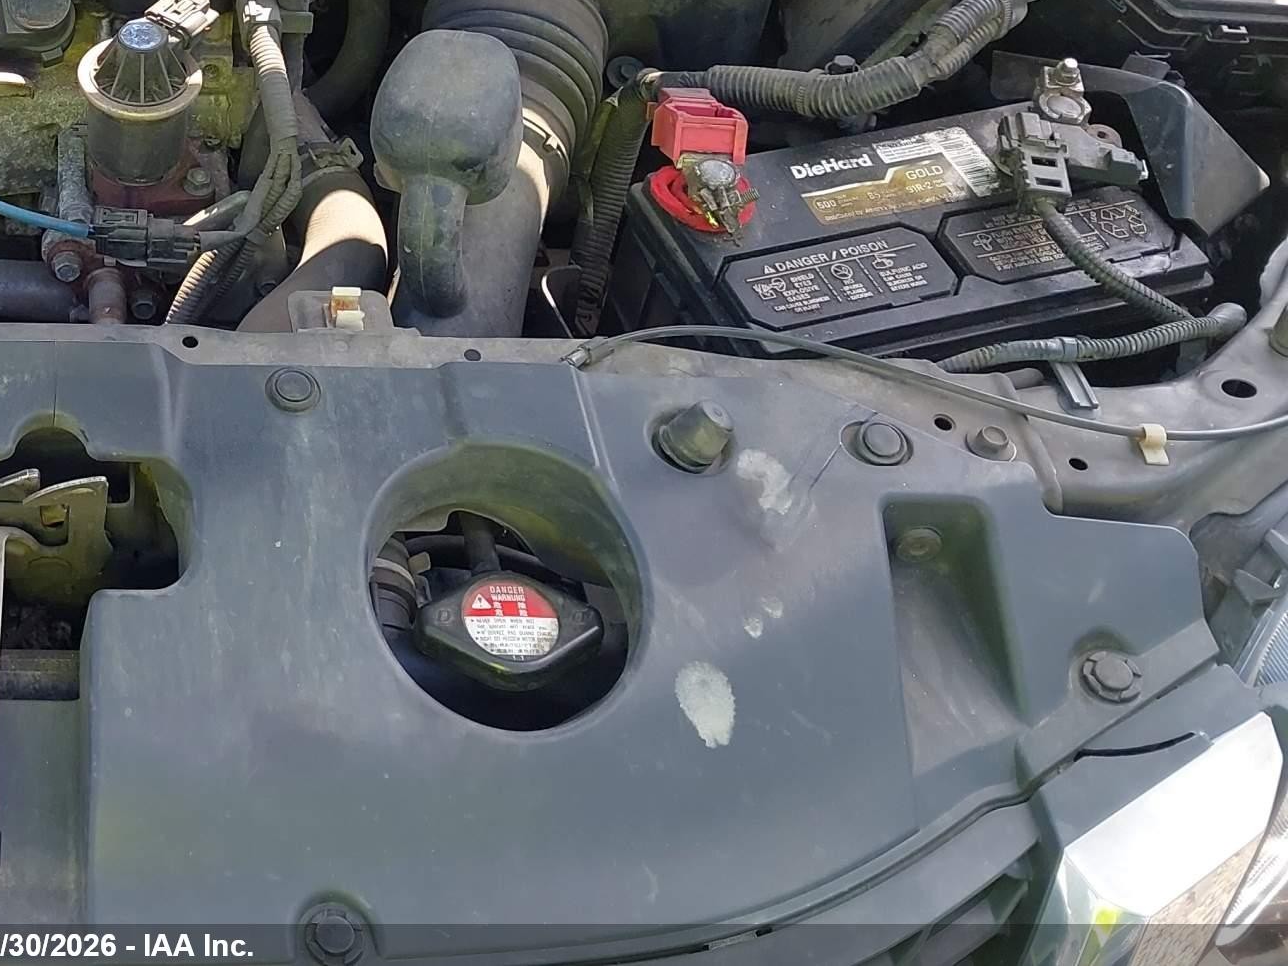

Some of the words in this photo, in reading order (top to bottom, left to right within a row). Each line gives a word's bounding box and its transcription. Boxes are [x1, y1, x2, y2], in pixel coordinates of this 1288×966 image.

[789, 153, 874, 180] DieHard
[905, 165, 944, 181] GOLD
[816, 198, 838, 210] 500
[775, 251, 830, 273] DANGER
[841, 240, 889, 258] POISON
[783, 285, 821, 297] EXPLOSIVE
[489, 586, 524, 594] DANGER
[490, 594, 526, 602] WARNUNG
